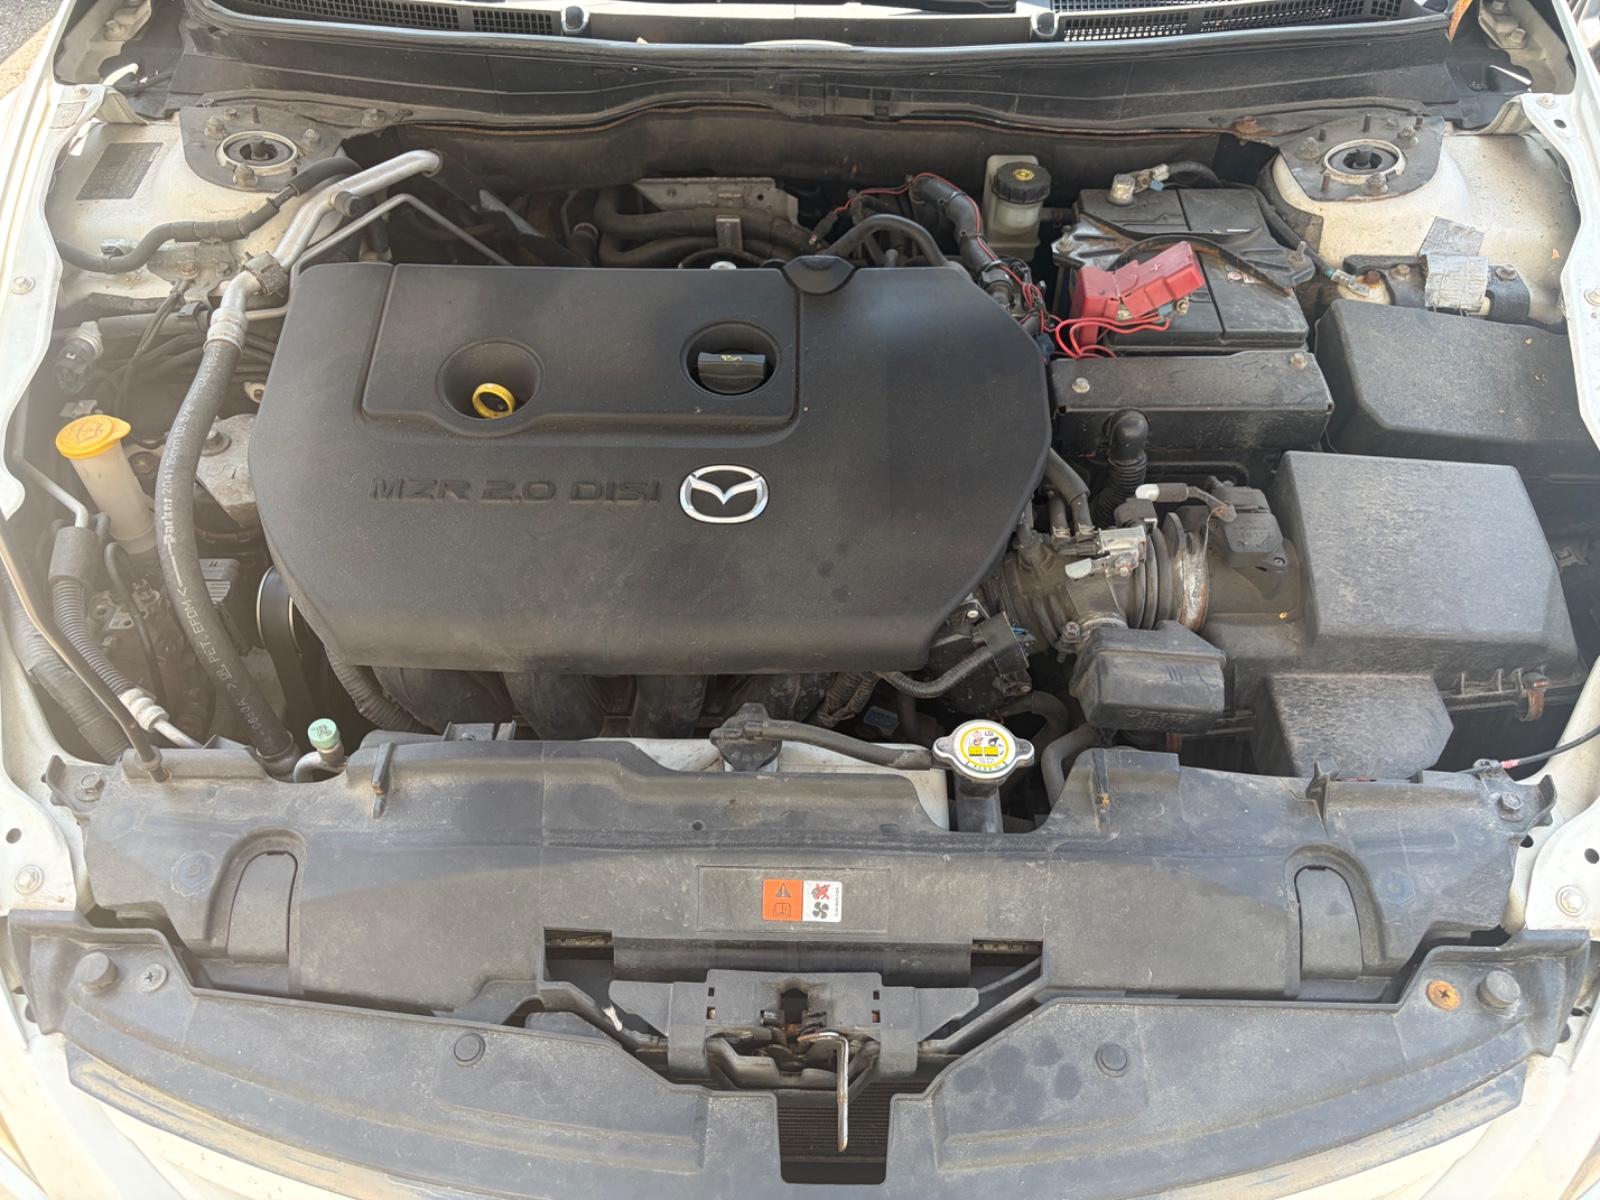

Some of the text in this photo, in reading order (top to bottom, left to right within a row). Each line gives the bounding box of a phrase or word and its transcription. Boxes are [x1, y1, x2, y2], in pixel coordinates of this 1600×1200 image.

[163, 469, 173, 494] 2041
[370, 478, 661, 505] MZR 2.0 DISI
[161, 497, 176, 545] Parker
